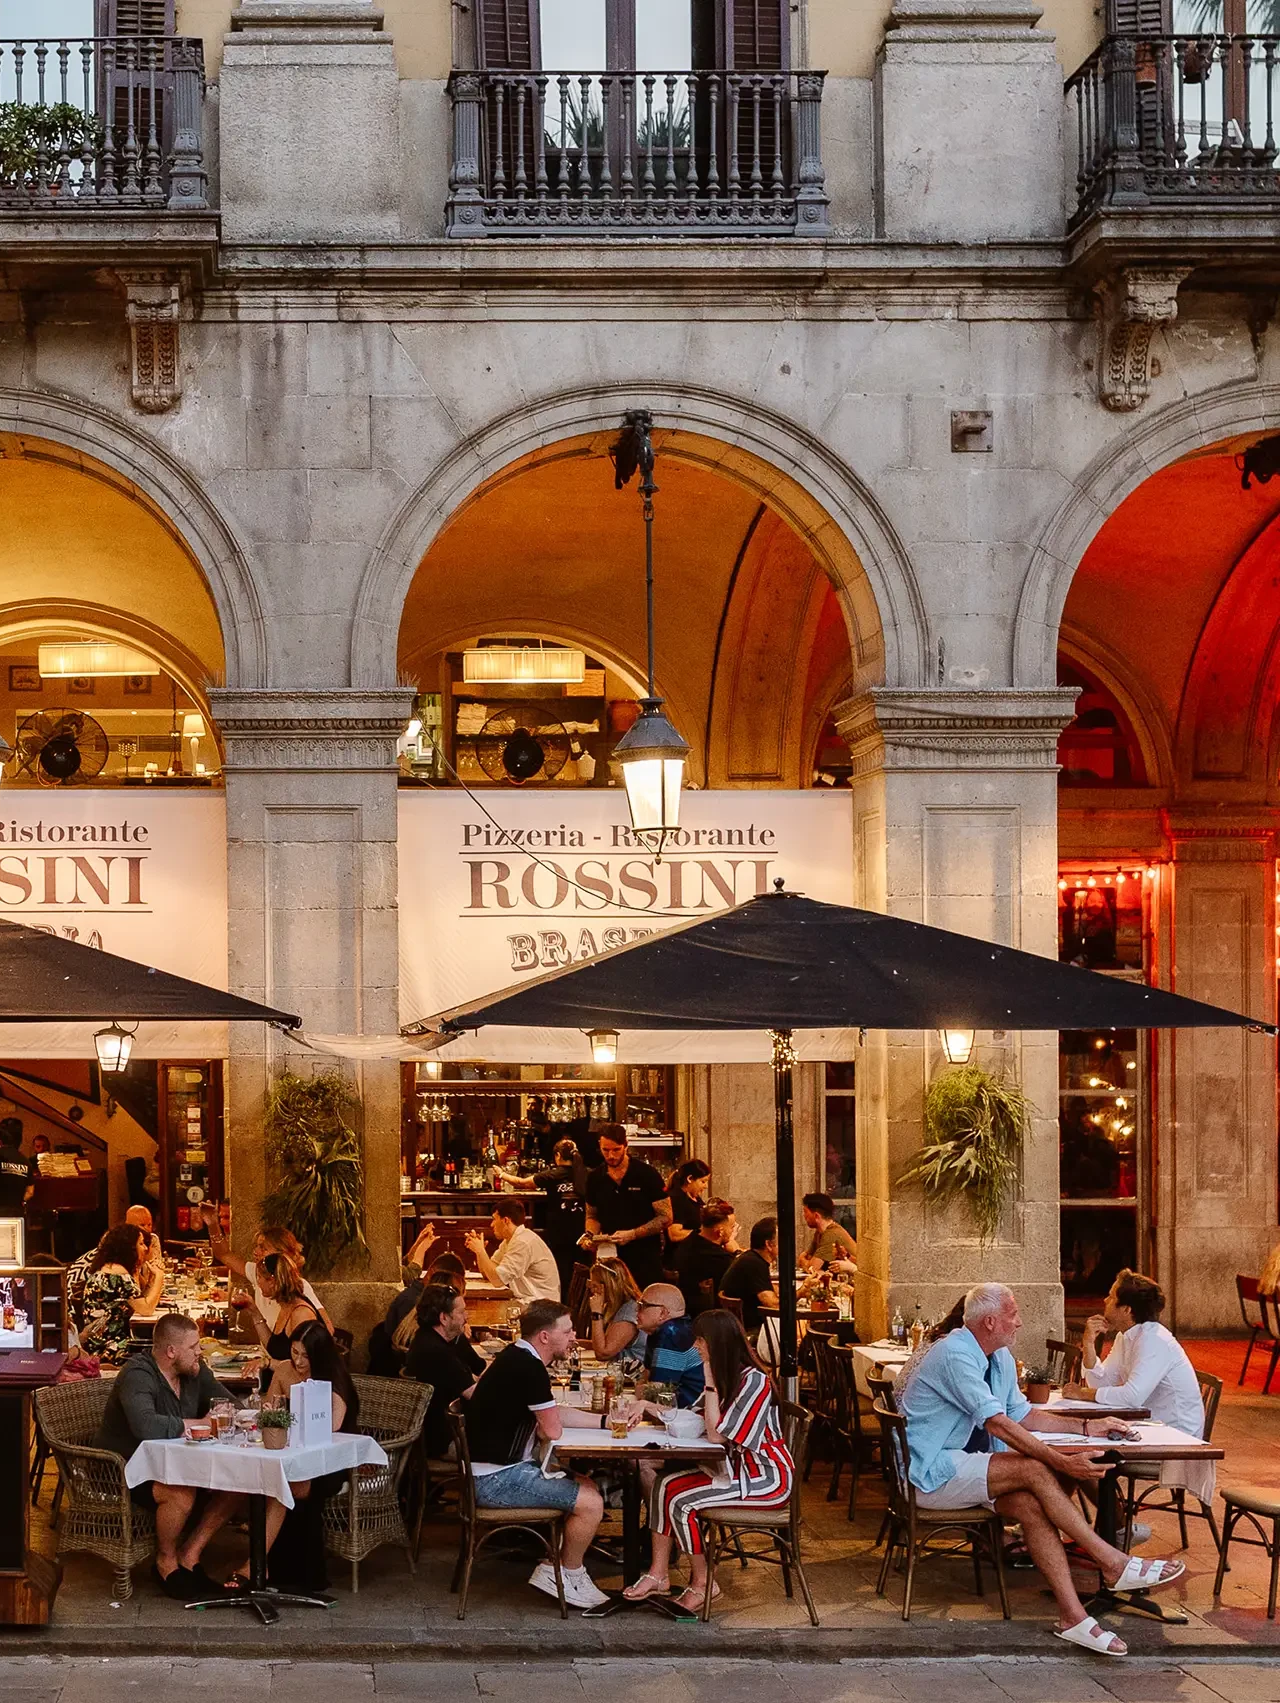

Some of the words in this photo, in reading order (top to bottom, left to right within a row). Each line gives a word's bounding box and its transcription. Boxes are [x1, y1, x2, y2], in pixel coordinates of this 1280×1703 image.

[461, 823, 586, 847] Pizzeria
[610, 823, 776, 847] Rsorante
[462, 860, 775, 911] ROSSINI
